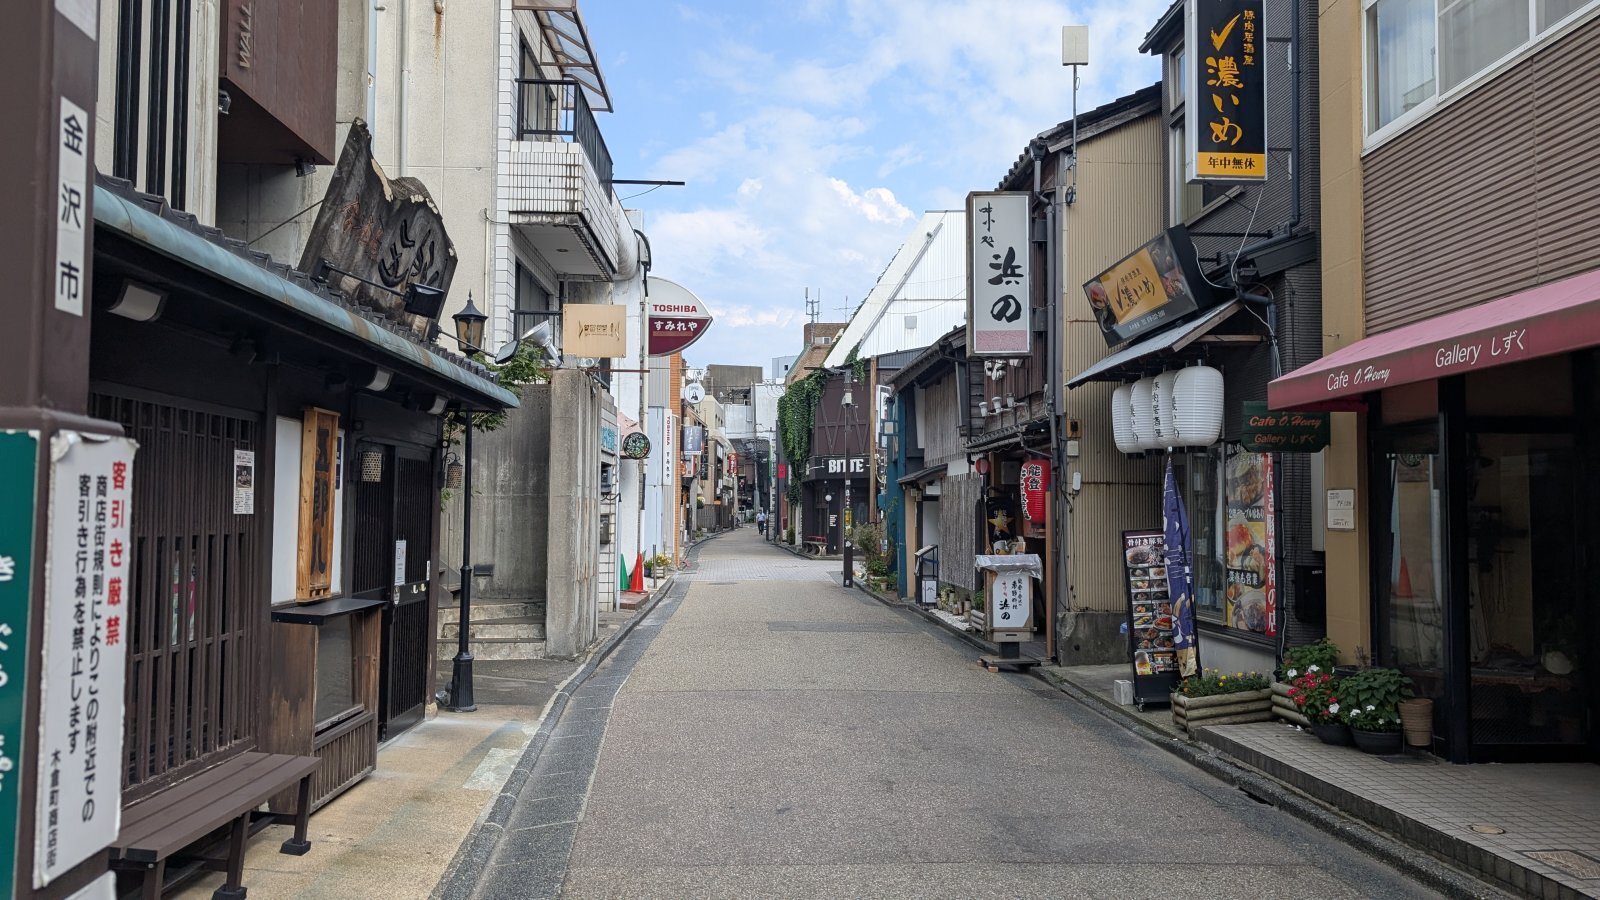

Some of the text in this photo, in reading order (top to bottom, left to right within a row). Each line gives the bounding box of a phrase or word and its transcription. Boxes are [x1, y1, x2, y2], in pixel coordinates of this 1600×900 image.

[1205, 56, 1244, 147] 濃いめ
[1208, 156, 1256, 170] 年中無休
[60, 114, 84, 301] 金沢市
[988, 246, 1024, 323] 浜の
[652, 304, 698, 313] TOSHIBA
[653, 320, 698, 332] すみれや
[1435, 329, 1526, 368] Gallery しずく
[1327, 372, 1349, 391] Cafe
[1249, 416, 1276, 427] Cafe
[1254, 433, 1287, 445] Gallery
[1028, 463, 1042, 491] 能登
[106, 460, 127, 646] 客引き厳禁
[68, 474, 92, 755] 客引き行為を禁止します
[999, 597, 1011, 621] 浜の
